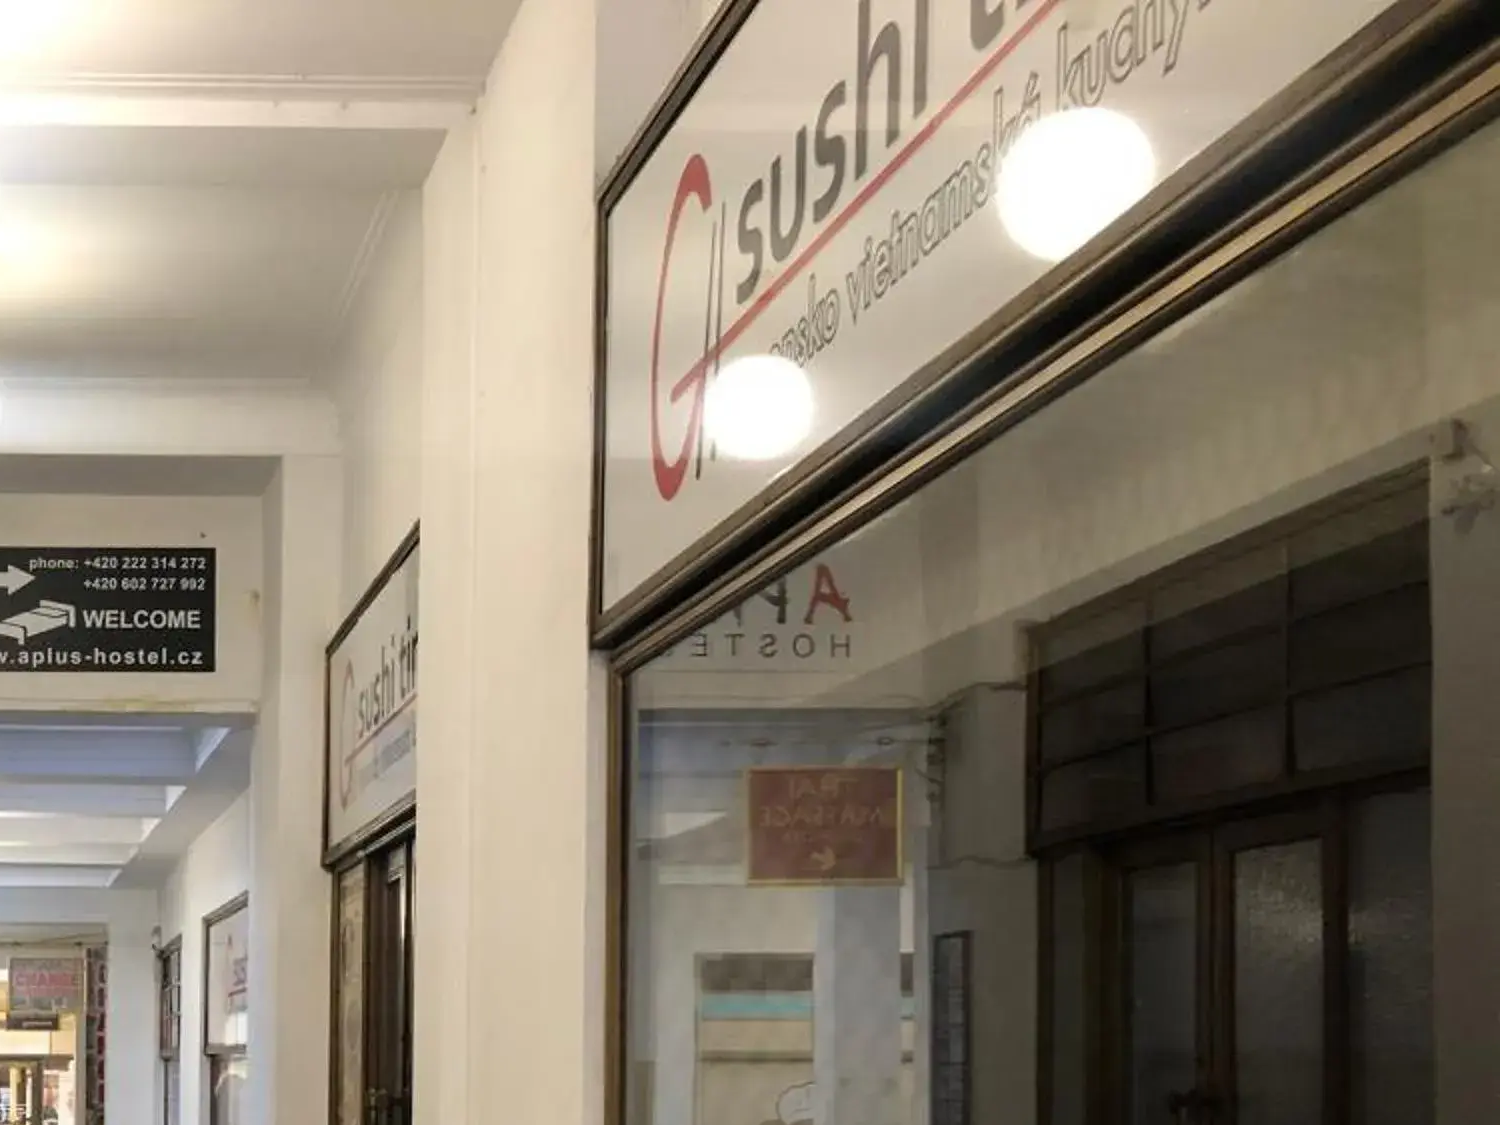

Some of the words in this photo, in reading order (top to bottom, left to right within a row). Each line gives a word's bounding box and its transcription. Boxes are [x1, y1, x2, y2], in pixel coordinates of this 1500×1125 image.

[29, 557, 79, 571] phone:
[84, 557, 117, 570] +420
[121, 557, 147, 570] 222
[151, 557, 177, 570] 314
[180, 557, 206, 570] 272
[83, 578, 117, 591] +420
[151, 578, 177, 591] 727
[82, 610, 201, 629] WELCOME
[358, 633, 396, 739] sushi
